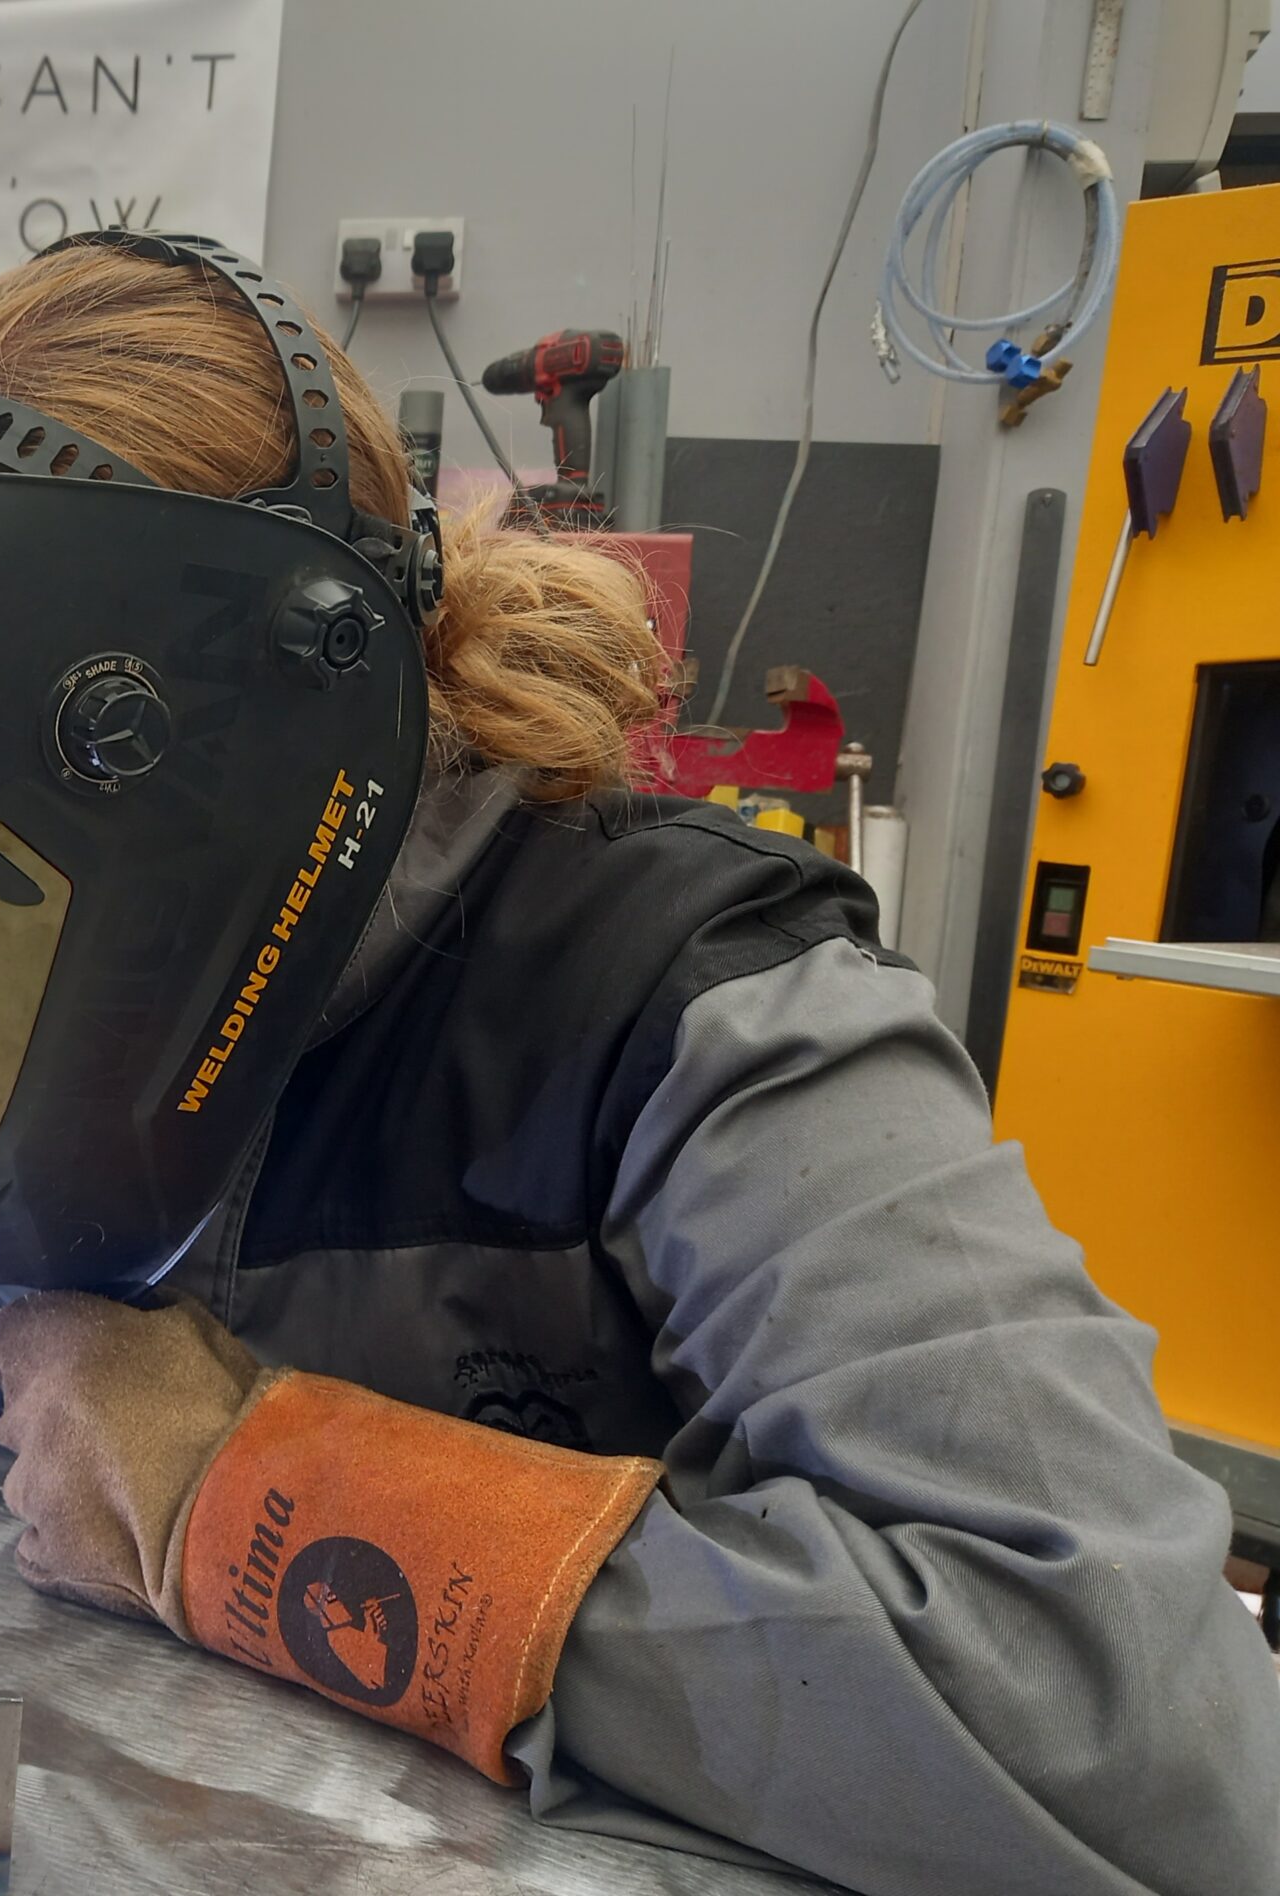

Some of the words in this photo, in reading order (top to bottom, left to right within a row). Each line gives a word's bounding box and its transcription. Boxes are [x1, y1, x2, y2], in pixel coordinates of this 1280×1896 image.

[85, 660, 118, 679] SHADE
[336, 778, 385, 870] H-21
[176, 944, 281, 1113] WELDING
[271, 768, 356, 943] HELMET
[224, 1486, 295, 1666] Ultima
